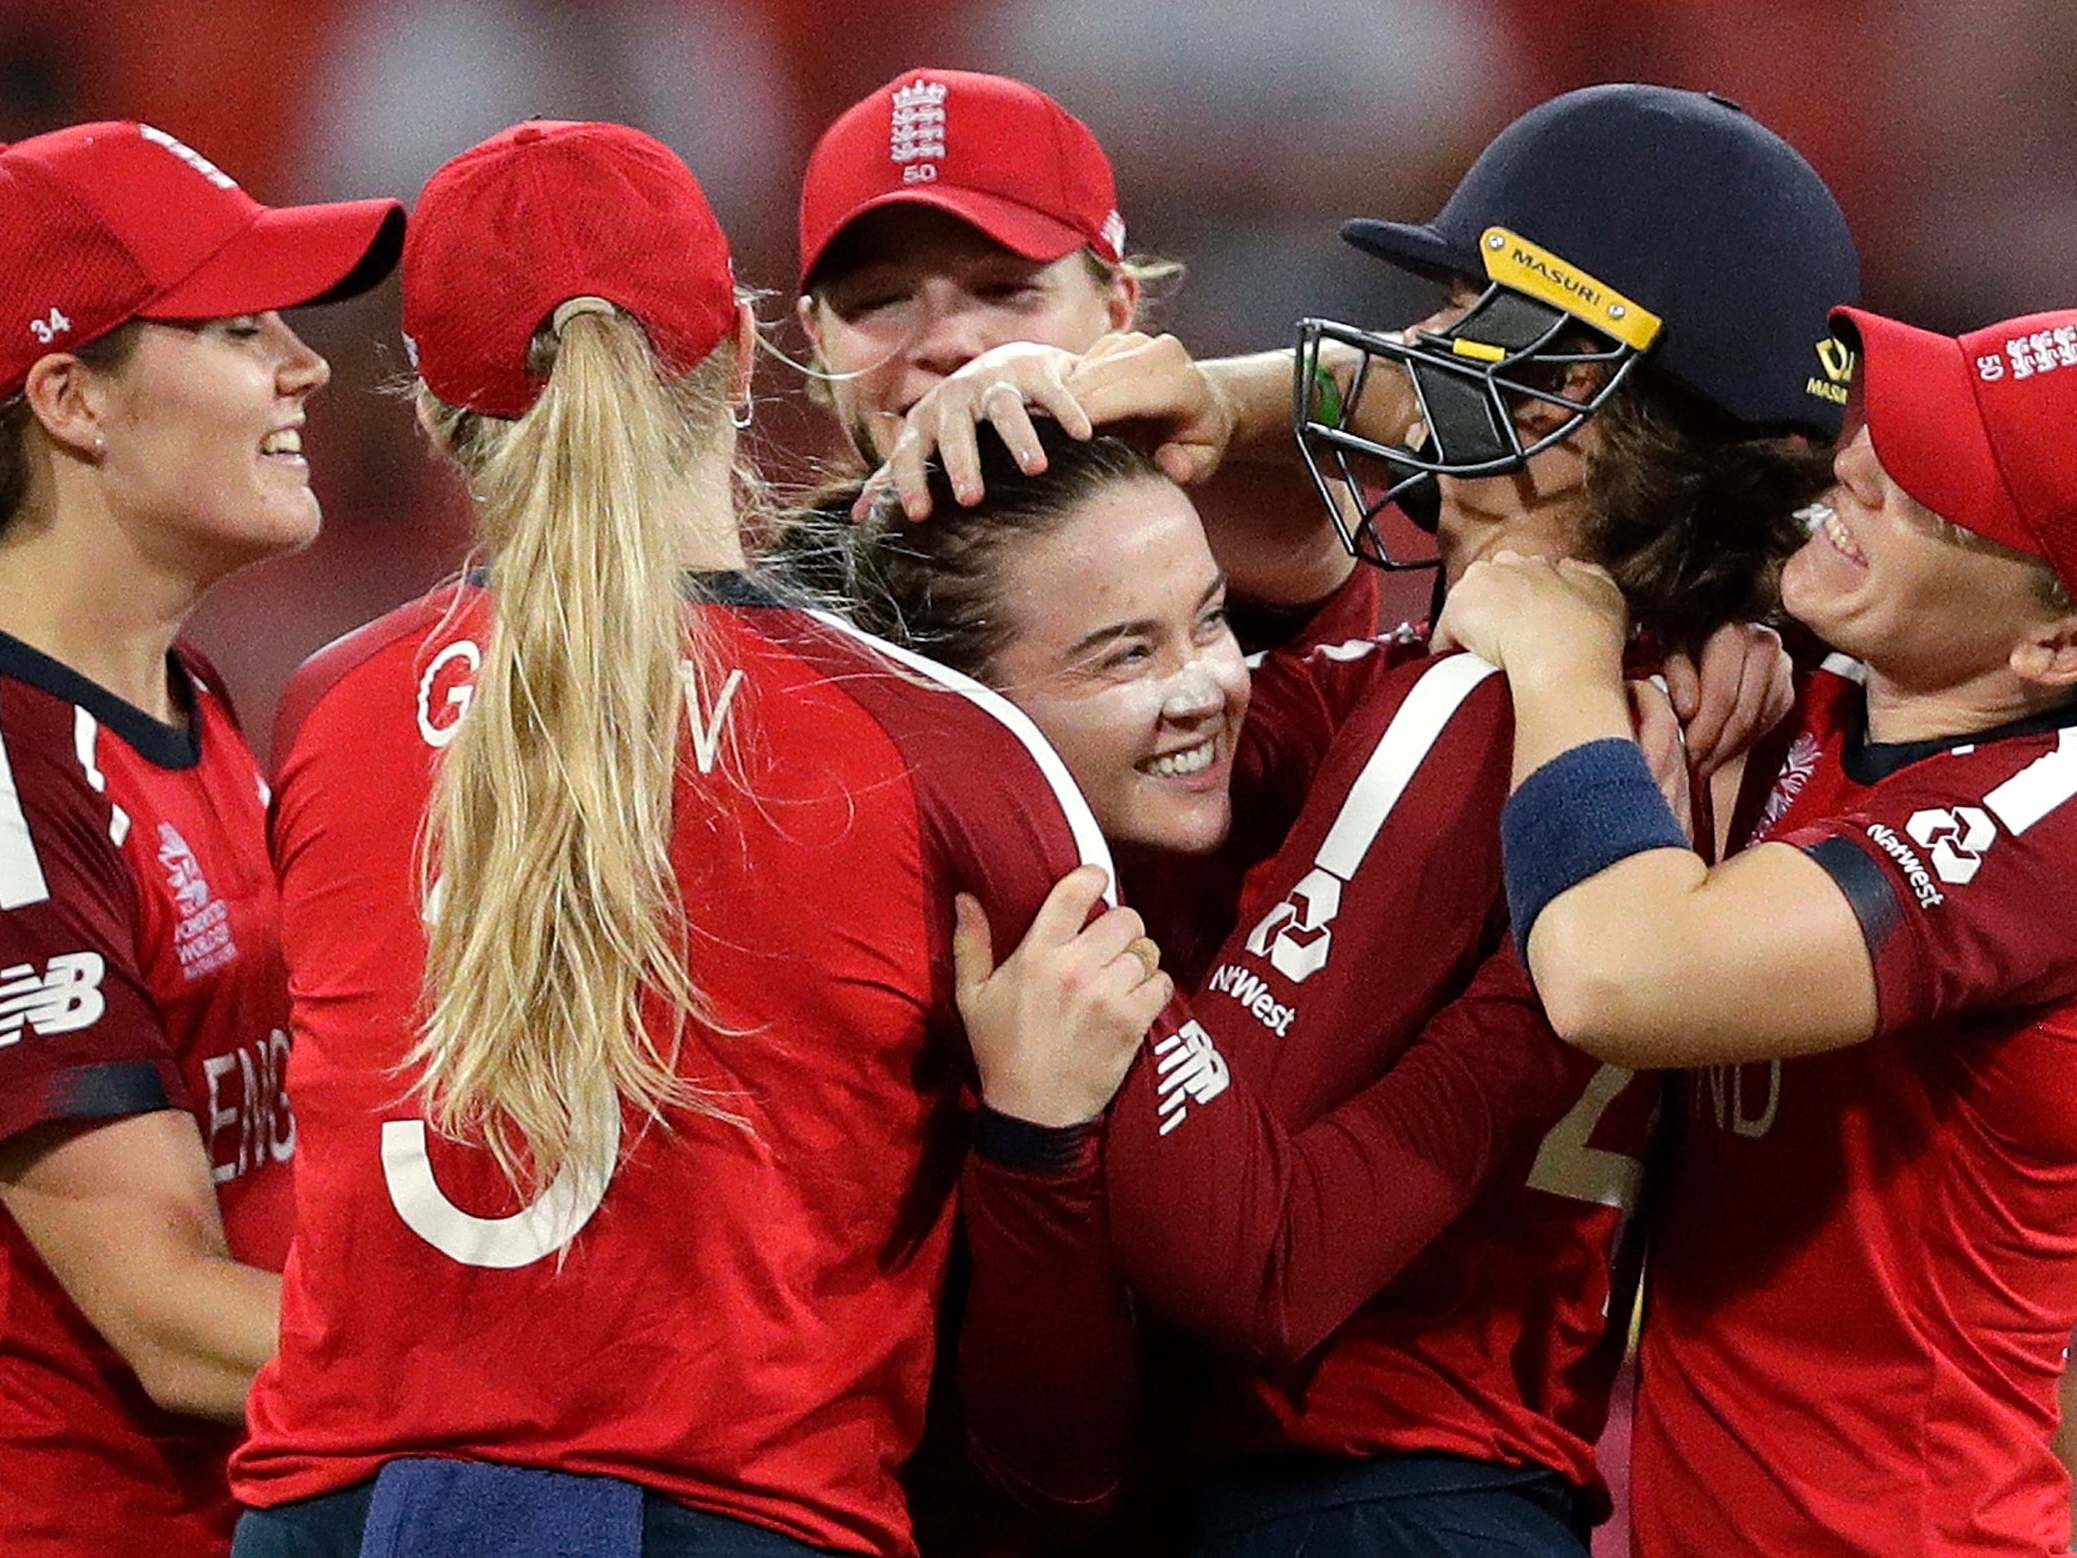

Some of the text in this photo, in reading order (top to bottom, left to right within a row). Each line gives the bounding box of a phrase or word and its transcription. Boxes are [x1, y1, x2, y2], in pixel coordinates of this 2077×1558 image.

[903, 163, 938, 184] 50
[1511, 248, 1601, 306] MASURI
[30, 307, 71, 344] 34
[1866, 823, 1944, 909] NatWest
